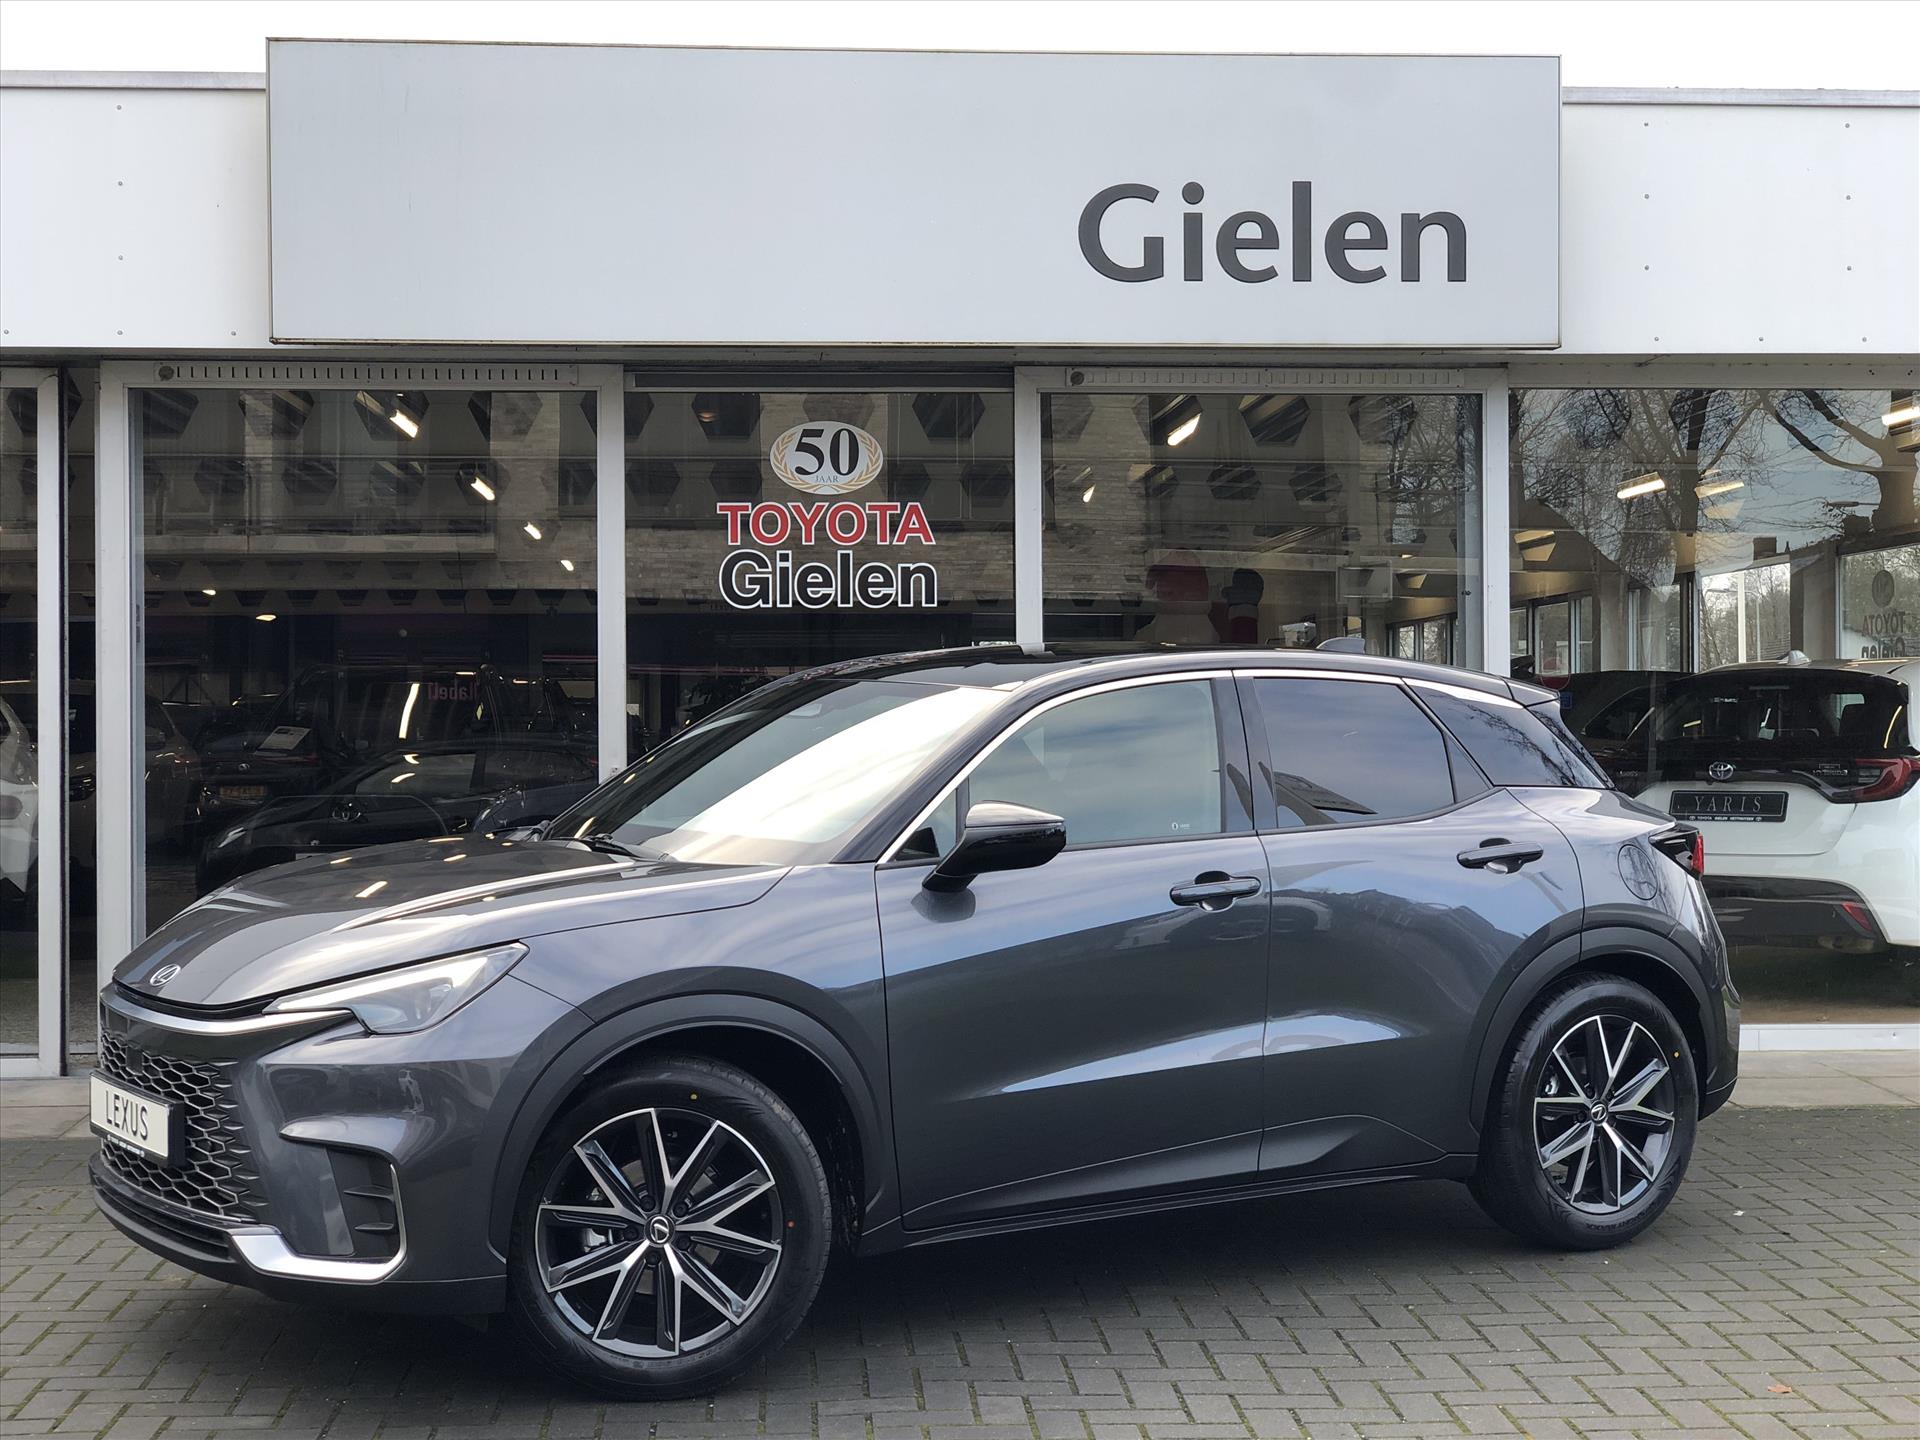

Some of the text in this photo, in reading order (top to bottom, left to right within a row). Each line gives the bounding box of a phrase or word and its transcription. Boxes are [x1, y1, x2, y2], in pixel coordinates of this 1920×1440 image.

[1078, 181, 1467, 284] Gielen
[794, 428, 860, 476] 50
[815, 475, 839, 484] JAAR
[716, 502, 936, 546] TOYOTA
[719, 549, 938, 609] Gielen
[1695, 795, 1762, 812] YARIS
[106, 1090, 148, 1141] LEXUS
